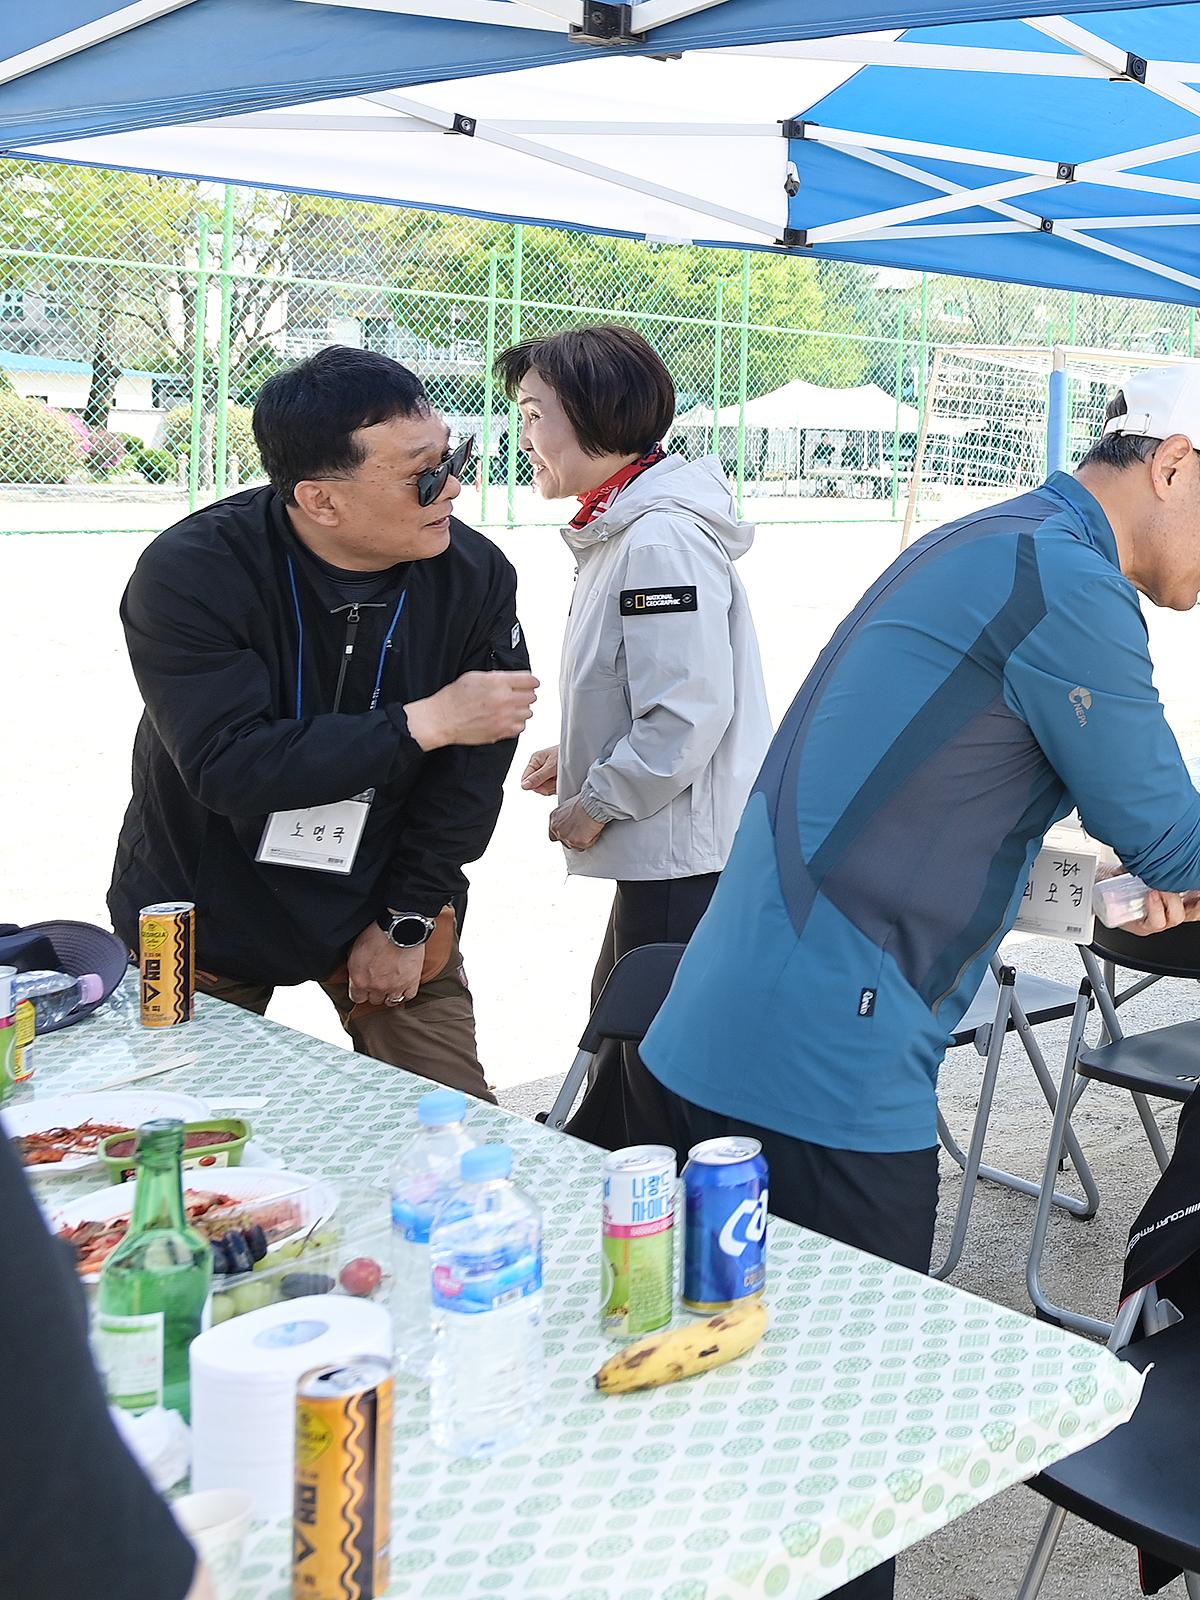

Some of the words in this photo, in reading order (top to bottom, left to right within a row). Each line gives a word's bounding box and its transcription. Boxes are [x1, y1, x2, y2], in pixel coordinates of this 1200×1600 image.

[645, 593, 674, 601] NATIONAL
[645, 598, 681, 607] GEOGRAPHIC
[1155, 1209, 1185, 1230] COURT
